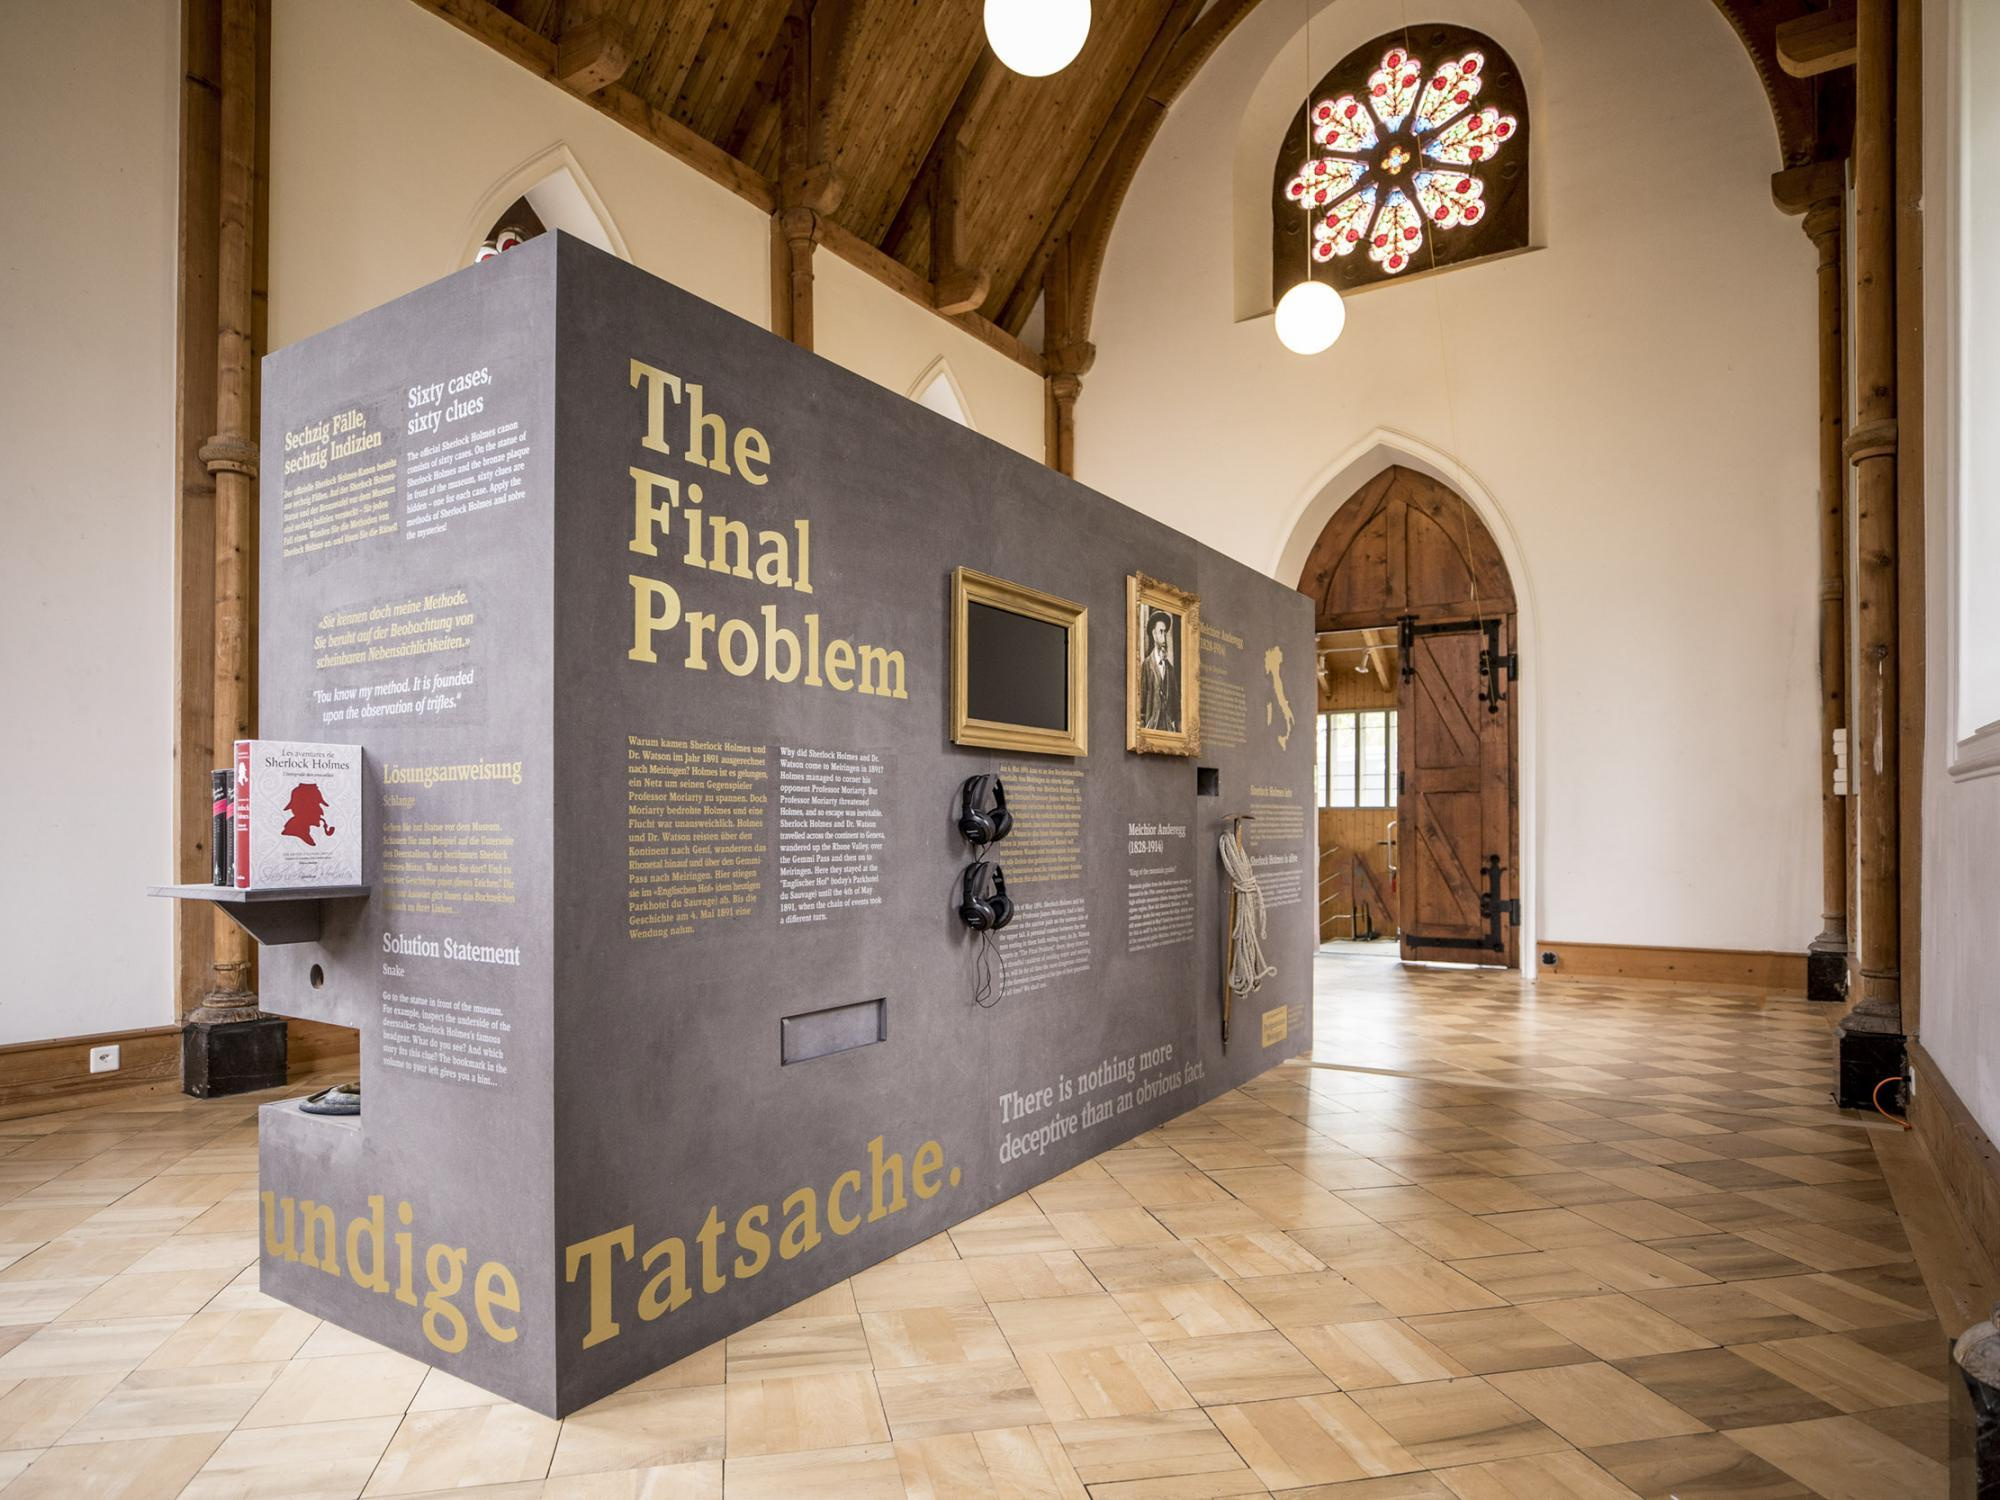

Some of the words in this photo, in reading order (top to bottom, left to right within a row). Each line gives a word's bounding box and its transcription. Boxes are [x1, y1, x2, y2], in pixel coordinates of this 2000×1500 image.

[408, 383, 444, 408] Sixty
[448, 368, 492, 394] cases,
[285, 422, 330, 451] Sechzig
[333, 409, 366, 435] Fälle,
[408, 411, 442, 435] sixty
[445, 397, 484, 422] clues
[630, 358, 770, 485] The
[284, 447, 328, 474] sechzig
[330, 432, 382, 460] Indizien
[629, 466, 813, 594] Final
[314, 636, 327, 650] Sie
[357, 627, 373, 645] auf
[373, 626, 389, 640] der
[390, 617, 453, 637] Beobachtung
[455, 613, 474, 626] von
[628, 574, 908, 699] Problem
[334, 688, 357, 701] know
[359, 686, 373, 701] my
[374, 679, 411, 696] method.
[413, 677, 421, 691] It
[422, 675, 431, 689] is
[432, 670, 474, 689] founded
[323, 710, 344, 724] upon
[346, 706, 359, 719] the
[361, 700, 413, 717] observation
[415, 697, 425, 715] of
[628, 736, 658, 746] Warum
[661, 738, 688, 749] kamen
[690, 740, 722, 751] Sherlock
[724, 742, 751, 753] Holmes
[752, 745, 766, 754] und
[629, 750, 640, 759] Dr.
[642, 750, 671, 761] Watson
[673, 752, 683, 762] im
[684, 753, 701, 764] Jahr
[703, 754, 719, 763] 1891
[780, 747, 795, 758] Why
[796, 749, 807, 757] did
[809, 749, 835, 759] Sherlock
[836, 752, 858, 761] Holmes
[859, 754, 871, 762] and
[871, 754, 879, 762] Dr.
[265, 757, 308, 768] Sherlock
[312, 759, 350, 769] Holmes
[383, 758, 522, 788] Lösungsanweisung
[628, 777, 642, 787] ein
[644, 778, 662, 787] Netz
[679, 779, 705, 789] seinen
[706, 780, 753, 791] Gegenspieler
[780, 819, 808, 827] Sherlock
[846, 819, 855, 827] Dr.
[856, 820, 877, 828] Watson
[1128, 823, 1157, 836] Melchior
[1157, 823, 1186, 838] Anderegg
[383, 932, 440, 957] Solution
[443, 938, 520, 965] Statement
[382, 963, 405, 977] Snake
[999, 1086, 1053, 1124] There
[1058, 1075, 1072, 1103] is
[1078, 1057, 1135, 1094] nothing
[1140, 1045, 1172, 1070] more
[999, 1114, 1078, 1164] deceptive
[1081, 1100, 1113, 1129] than
[1117, 1092, 1133, 1113] an
[1137, 1072, 1180, 1104] obvious
[1185, 1061, 1204, 1084] fact.
[566, 1135, 961, 1350] Tatsache.
[261, 1191, 520, 1354] undige
